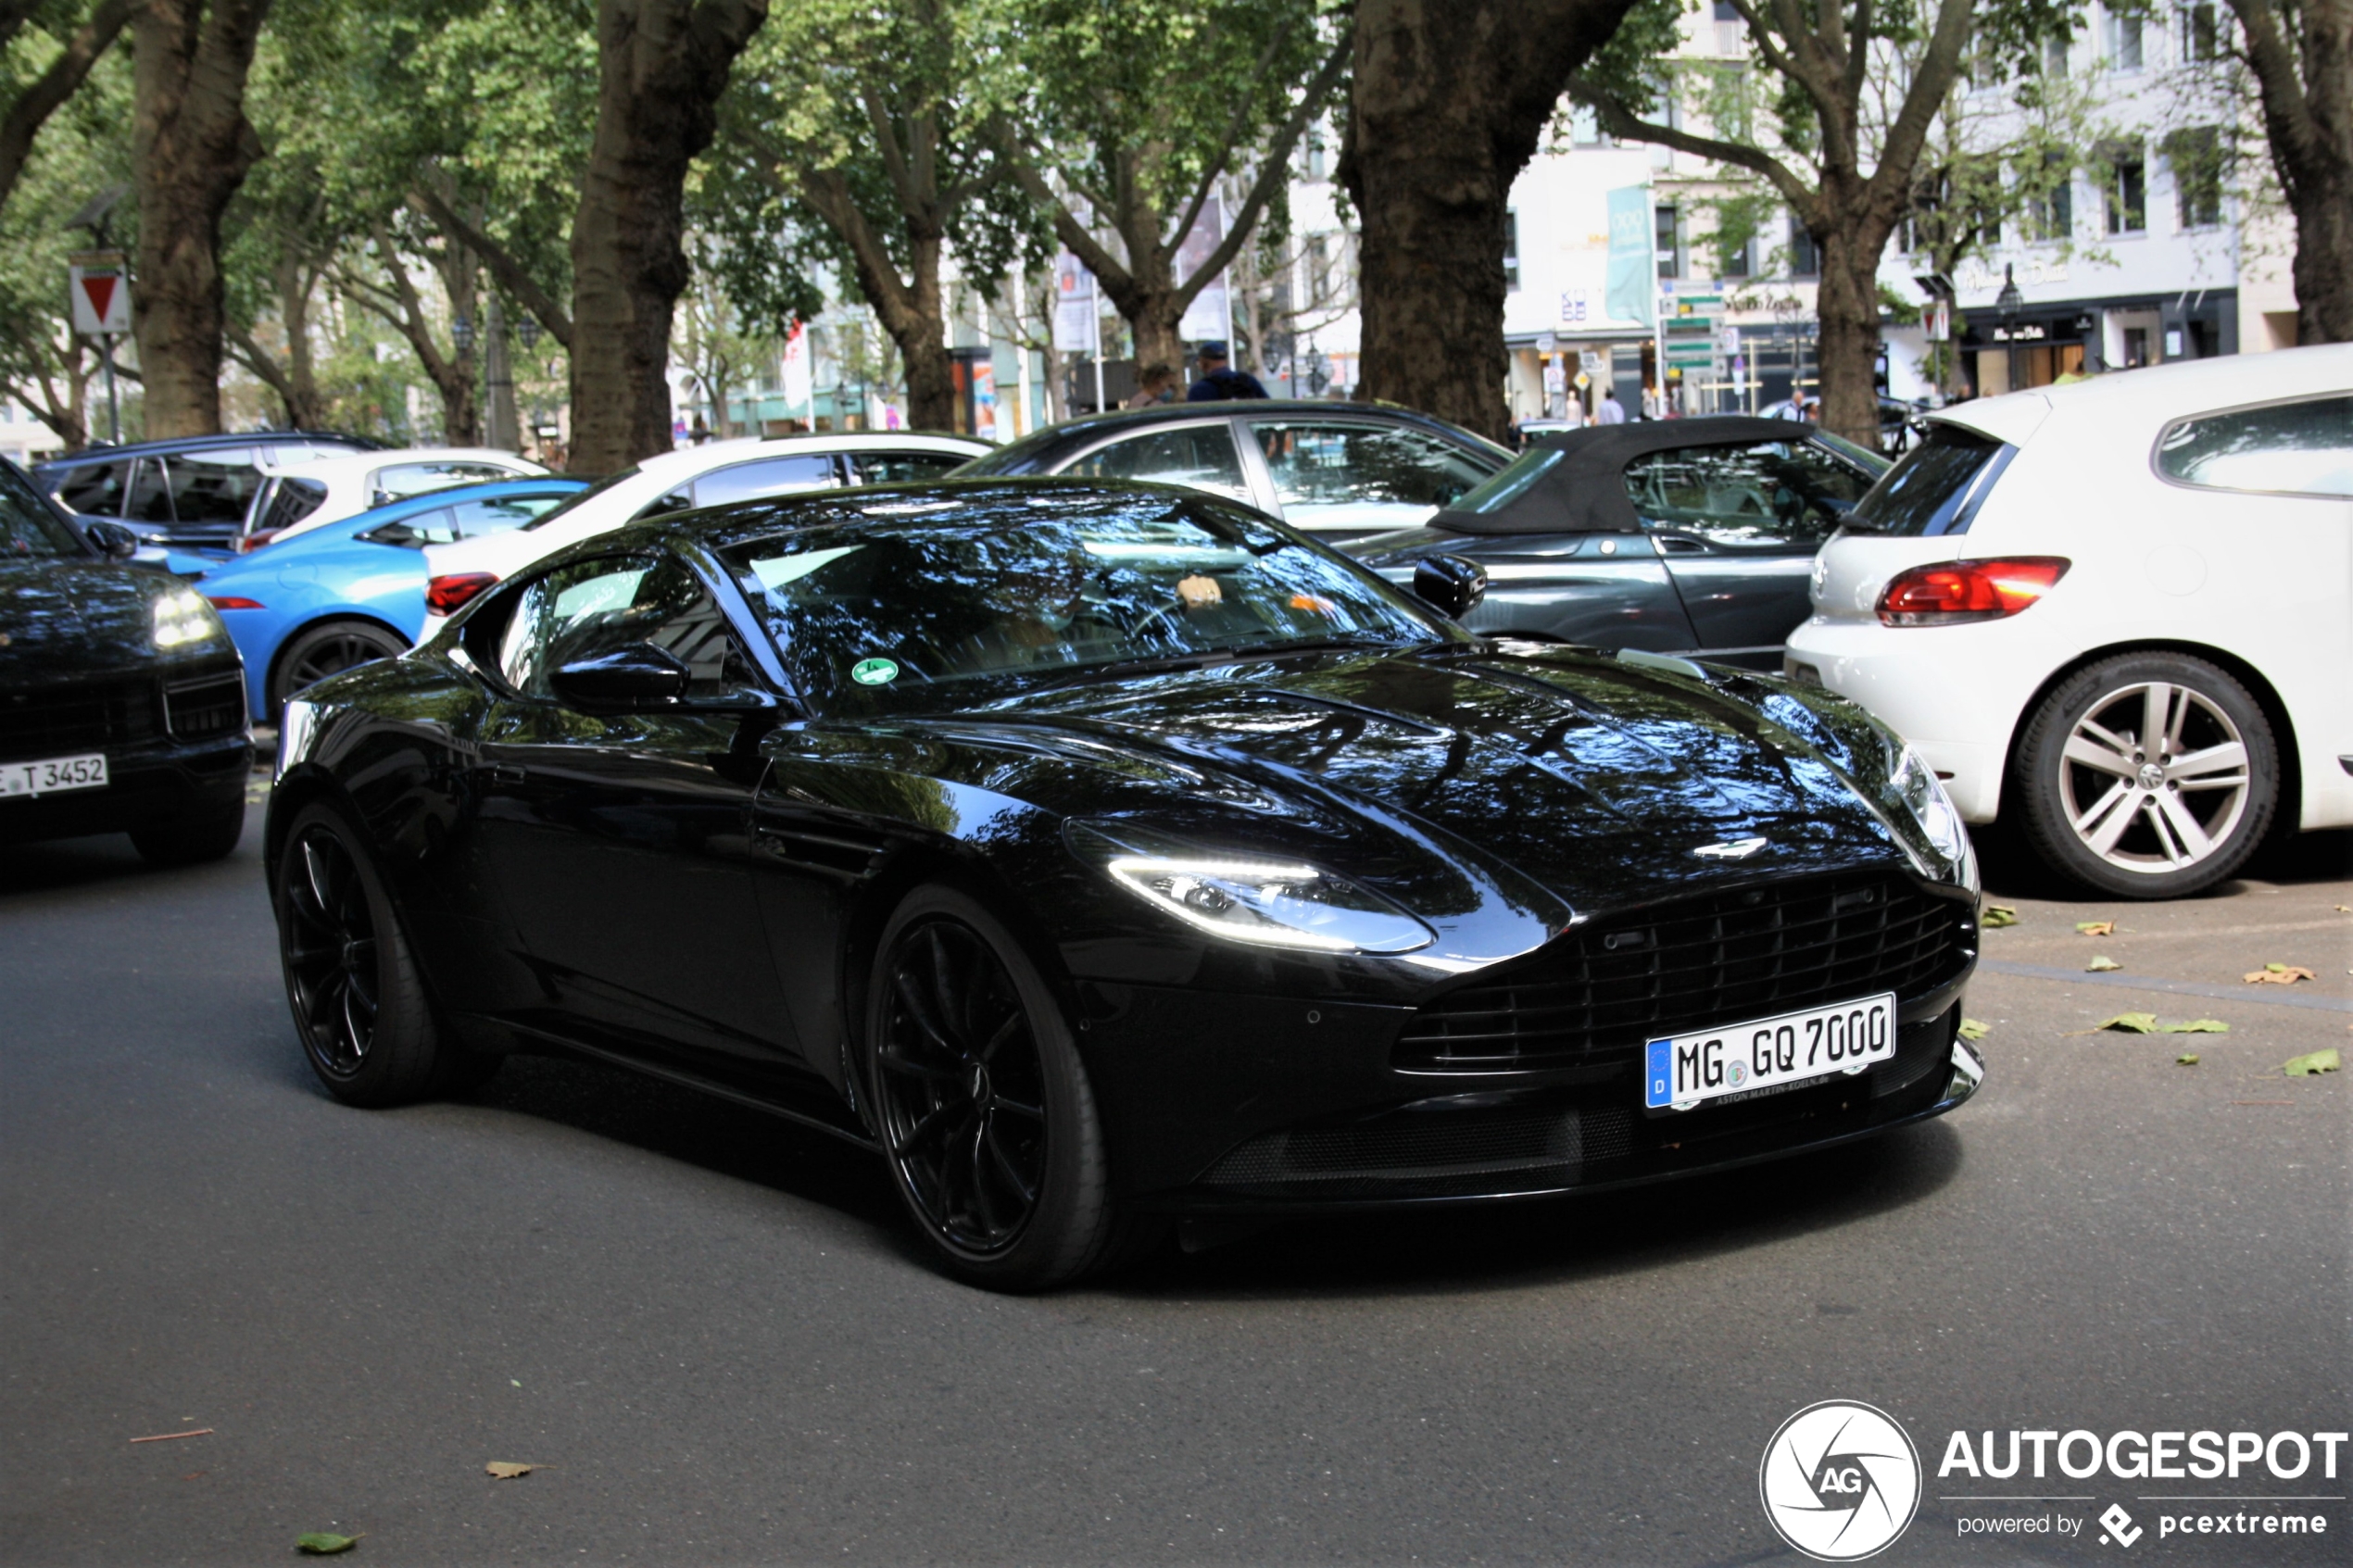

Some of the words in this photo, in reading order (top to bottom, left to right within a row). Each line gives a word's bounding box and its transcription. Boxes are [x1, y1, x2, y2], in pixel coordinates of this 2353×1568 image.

[23, 767, 37, 790] T
[44, 759, 104, 787] 3452
[1677, 1038, 1724, 1093] MG
[1753, 1024, 1795, 1076] GQ
[1806, 1005, 1885, 1066] 7000
[1655, 1080, 1665, 1095] D
[1716, 1091, 1748, 1106] ASTON
